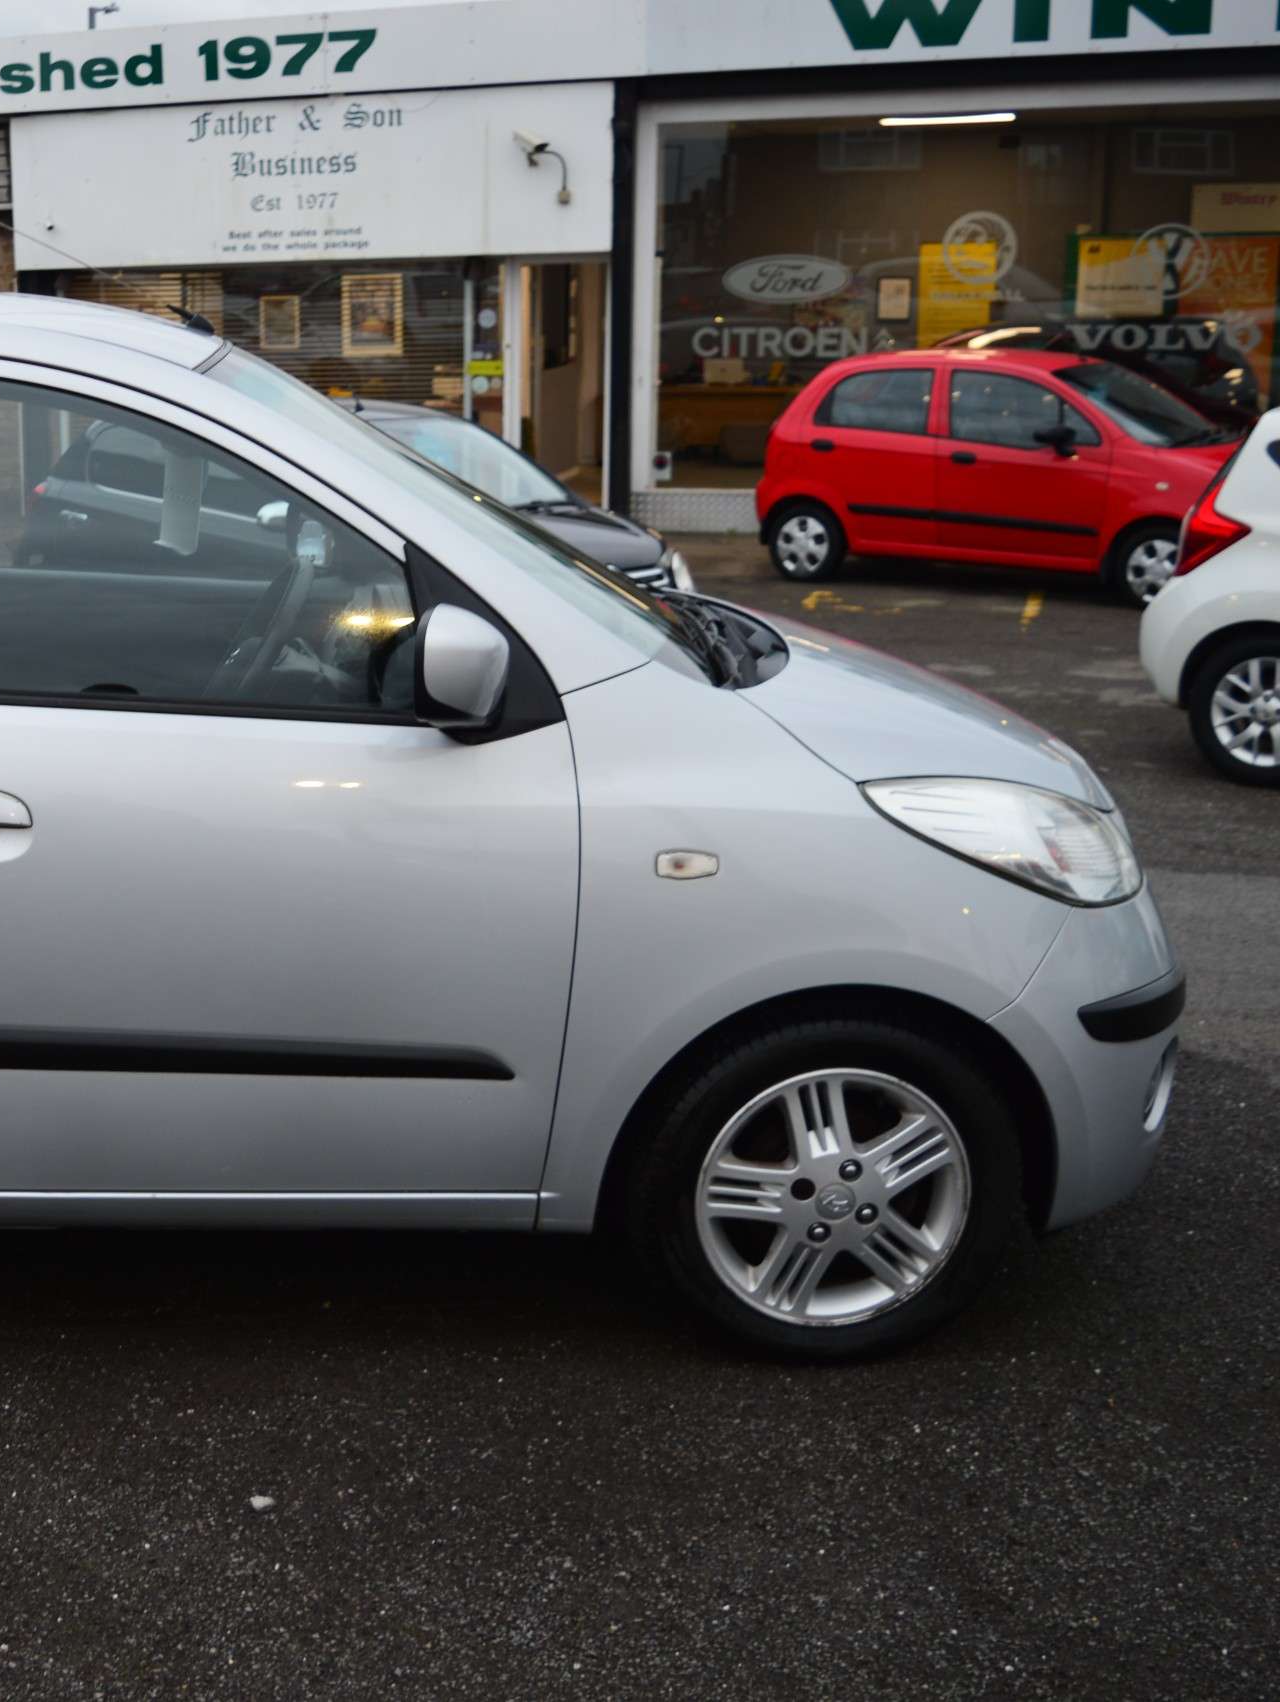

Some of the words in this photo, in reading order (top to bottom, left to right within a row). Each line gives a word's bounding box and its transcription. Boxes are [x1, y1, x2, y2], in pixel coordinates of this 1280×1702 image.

[198, 28, 378, 82] 1977
[187, 109, 277, 142] Father
[298, 104, 322, 132] &
[343, 102, 404, 129] Son
[230, 151, 358, 178] Business
[249, 194, 282, 213] Est
[296, 192, 340, 210] 1977
[257, 229, 284, 239] after
[323, 226, 363, 237] around
[261, 241, 280, 251] the
[285, 240, 318, 251] whole
[323, 238, 370, 251] package
[749, 263, 825, 293] Ford
[1065, 322, 1264, 353] VOLVO
